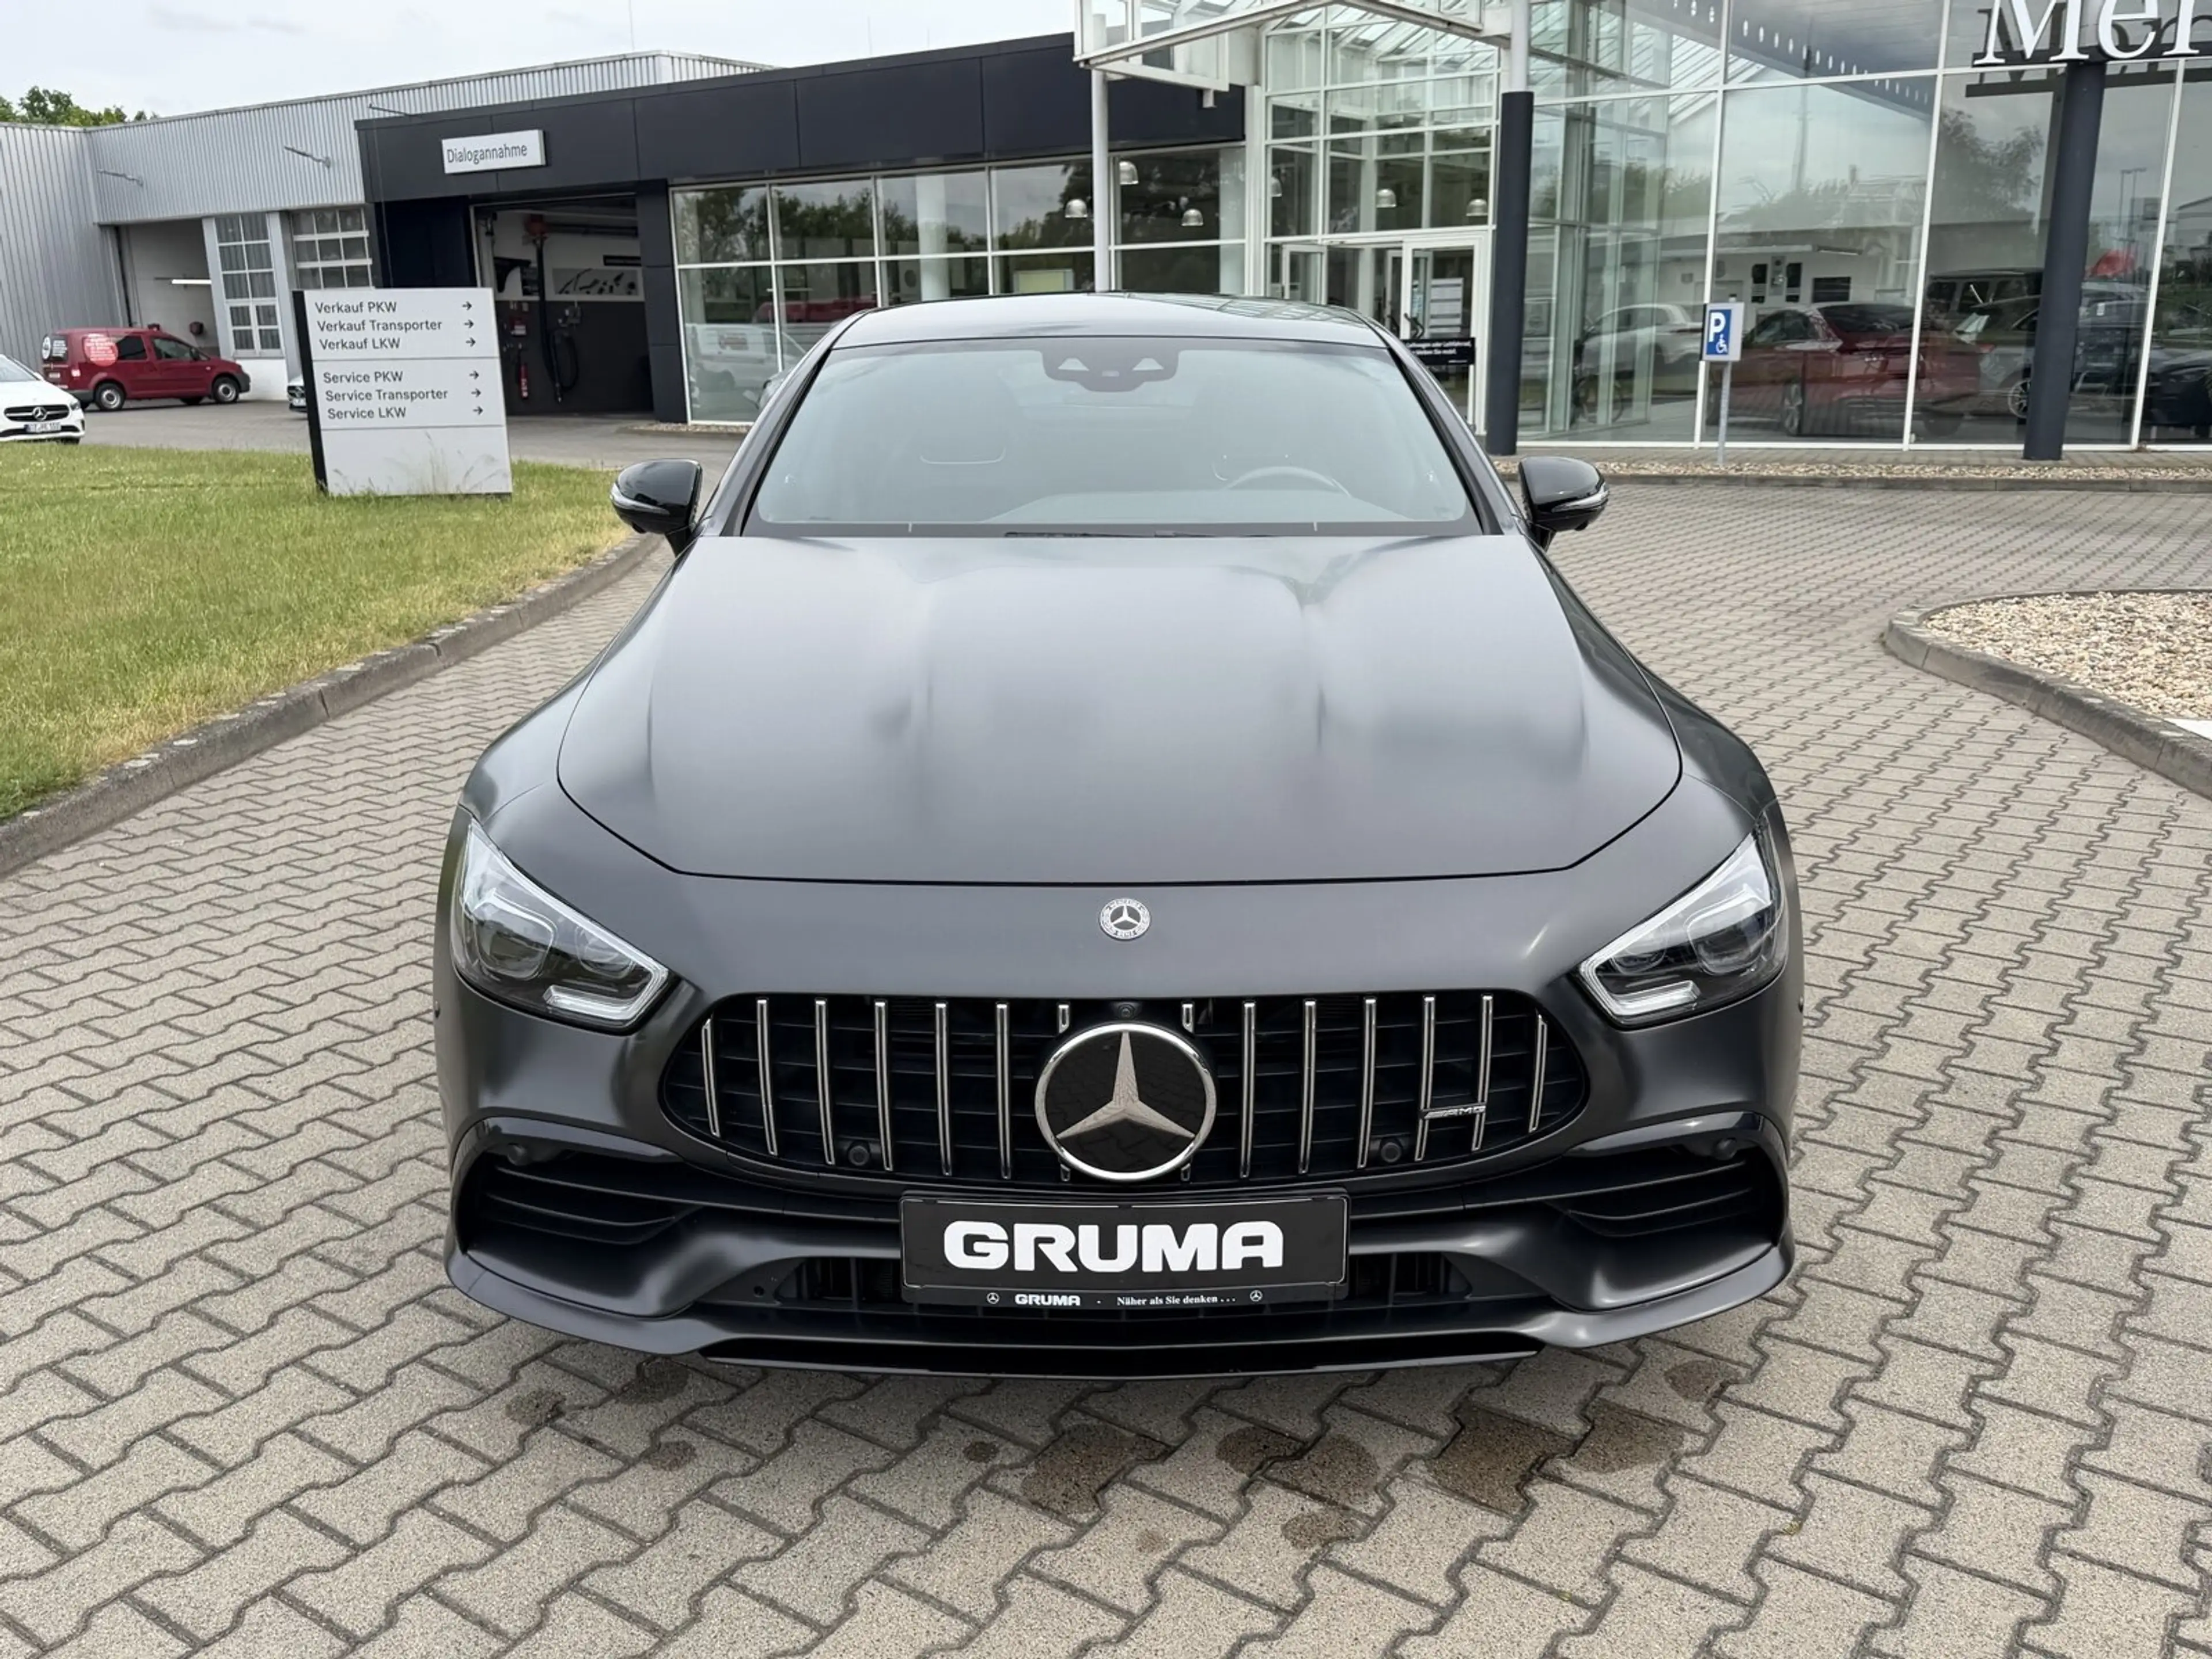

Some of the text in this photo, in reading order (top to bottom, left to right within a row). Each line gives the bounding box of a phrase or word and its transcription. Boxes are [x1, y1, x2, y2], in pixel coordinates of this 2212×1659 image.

[446, 144, 528, 165] Dialogannahme
[315, 302, 397, 313] Verkauf PKW
[317, 320, 442, 333] Verkauf Transporter
[1709, 312, 1726, 342] P
[319, 338, 400, 350] Verkauf LKW
[323, 372, 403, 384] Service PKW
[325, 390, 448, 402] Service Transporter
[327, 408, 406, 420] Service LKW
[944, 1221, 1284, 1272] GRUMA
[1015, 1294, 1081, 1306] GRUMA
[1117, 1297, 1147, 1305] Näher
[1150, 1297, 1162, 1305] als
[1165, 1296, 1181, 1305] Sie
